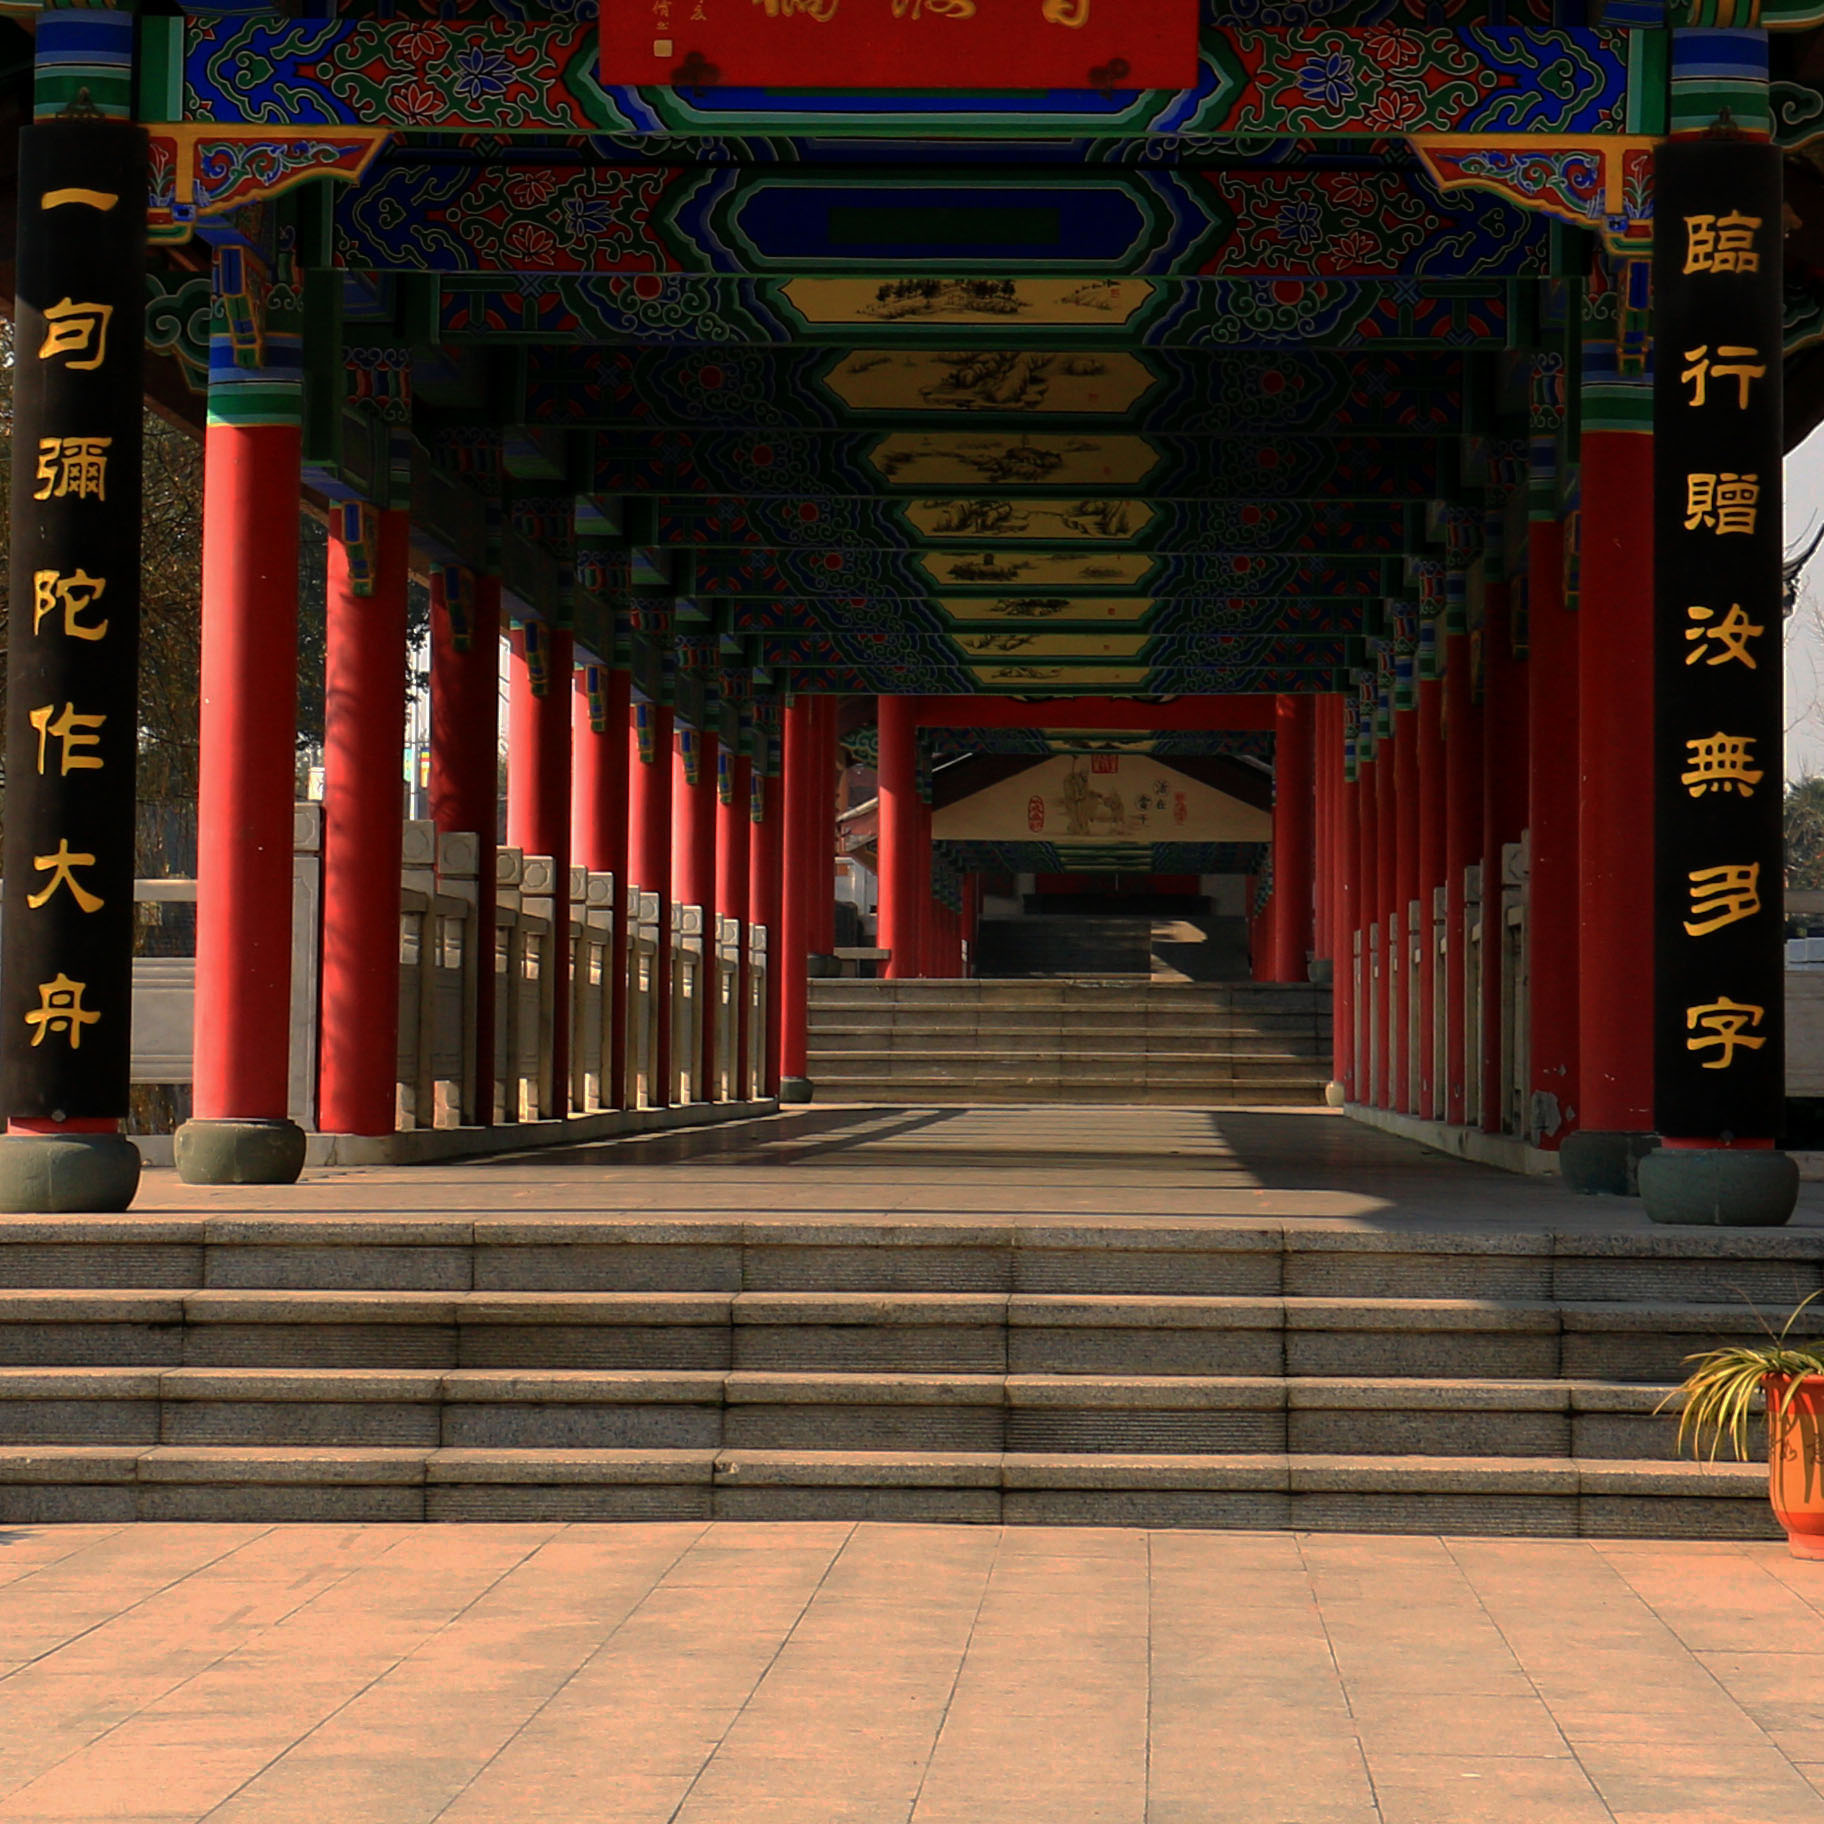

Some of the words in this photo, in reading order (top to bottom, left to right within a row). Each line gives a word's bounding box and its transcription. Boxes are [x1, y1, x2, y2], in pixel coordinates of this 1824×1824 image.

[24, 188, 118, 1049] 一句彌陀作大舟
[1680, 209, 1766, 1069] 臨行贈汝無多字
